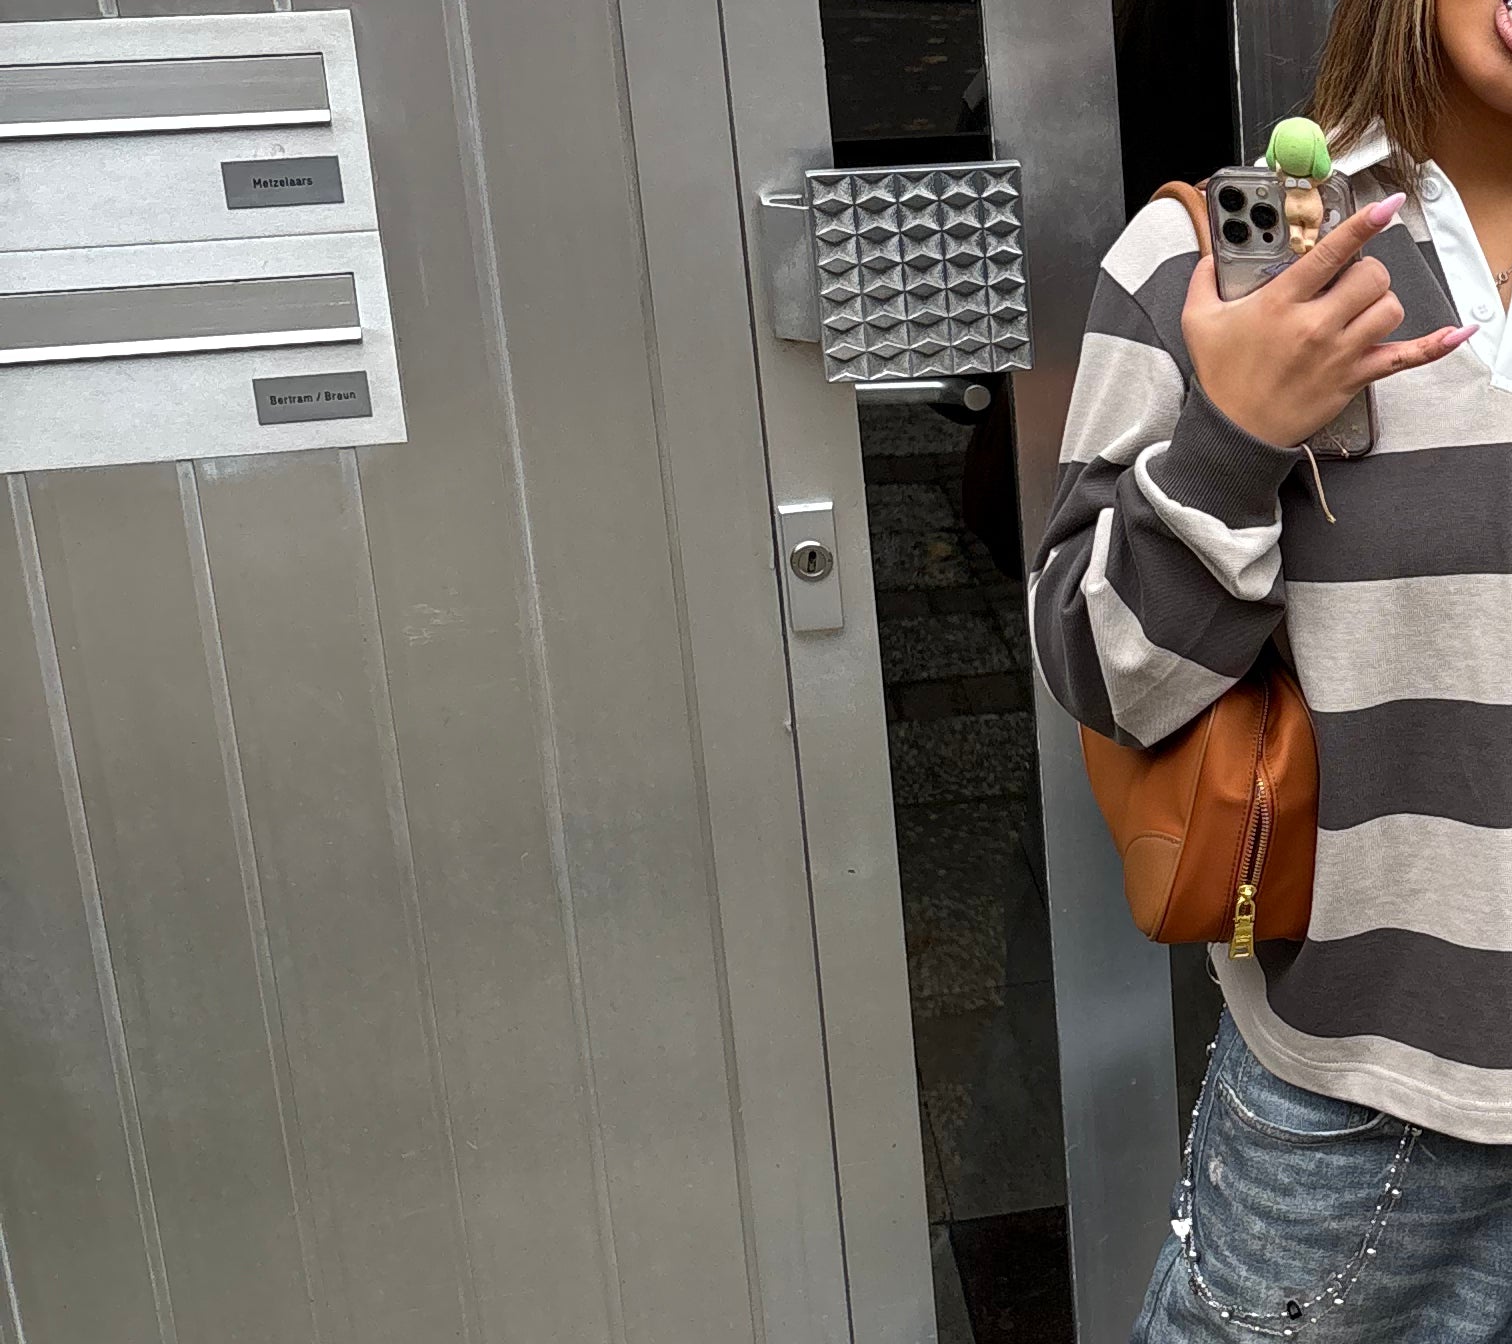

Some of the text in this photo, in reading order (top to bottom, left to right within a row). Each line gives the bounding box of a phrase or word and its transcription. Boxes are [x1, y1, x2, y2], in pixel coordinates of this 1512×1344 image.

[252, 176, 313, 190] Metzelaars
[269, 393, 313, 406] Bertram
[324, 390, 357, 402] Braun
